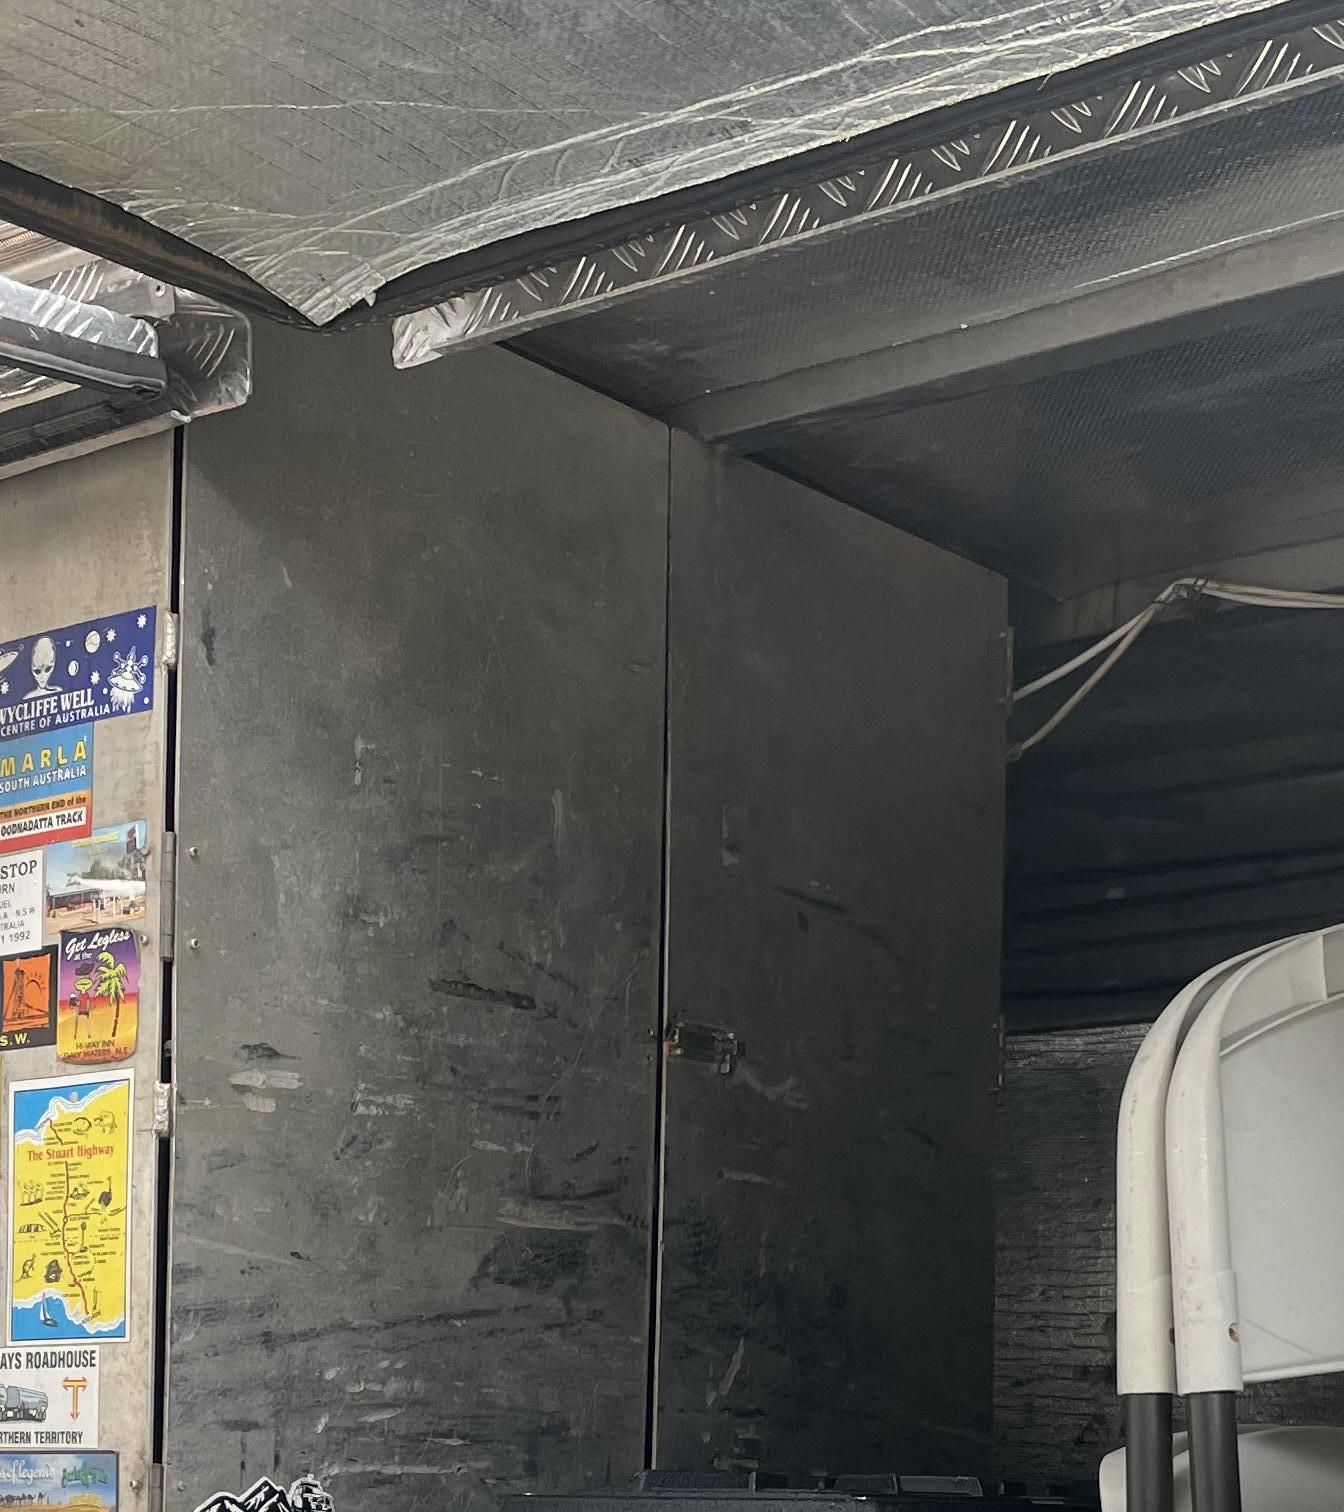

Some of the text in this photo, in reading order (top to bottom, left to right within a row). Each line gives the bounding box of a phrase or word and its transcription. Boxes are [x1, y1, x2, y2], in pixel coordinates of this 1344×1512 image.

[60, 688, 94, 711] WELL
[0, 721, 36, 737] CENTRE
[39, 717, 52, 729] OF
[55, 703, 111, 725] AUSTRALIA
[0, 739, 88, 777] MARLA
[0, 765, 87, 794] SOUTH AUSTRALIA
[0, 810, 13, 820] THE
[14, 803, 50, 817] NORTHERN
[0, 810, 83, 837] OODNADATTA TRACK
[0, 860, 37, 880] STOP
[9, 930, 31, 942] 1992
[65, 929, 131, 960] Get Legless
[101, 1039, 115, 1048] INN
[27, 1145, 114, 1161] The Stuart Highway
[25, 1349, 96, 1369] ROADHOUSE
[34, 1430, 84, 1444] TERRITORY
[18, 1459, 56, 1487] legends
